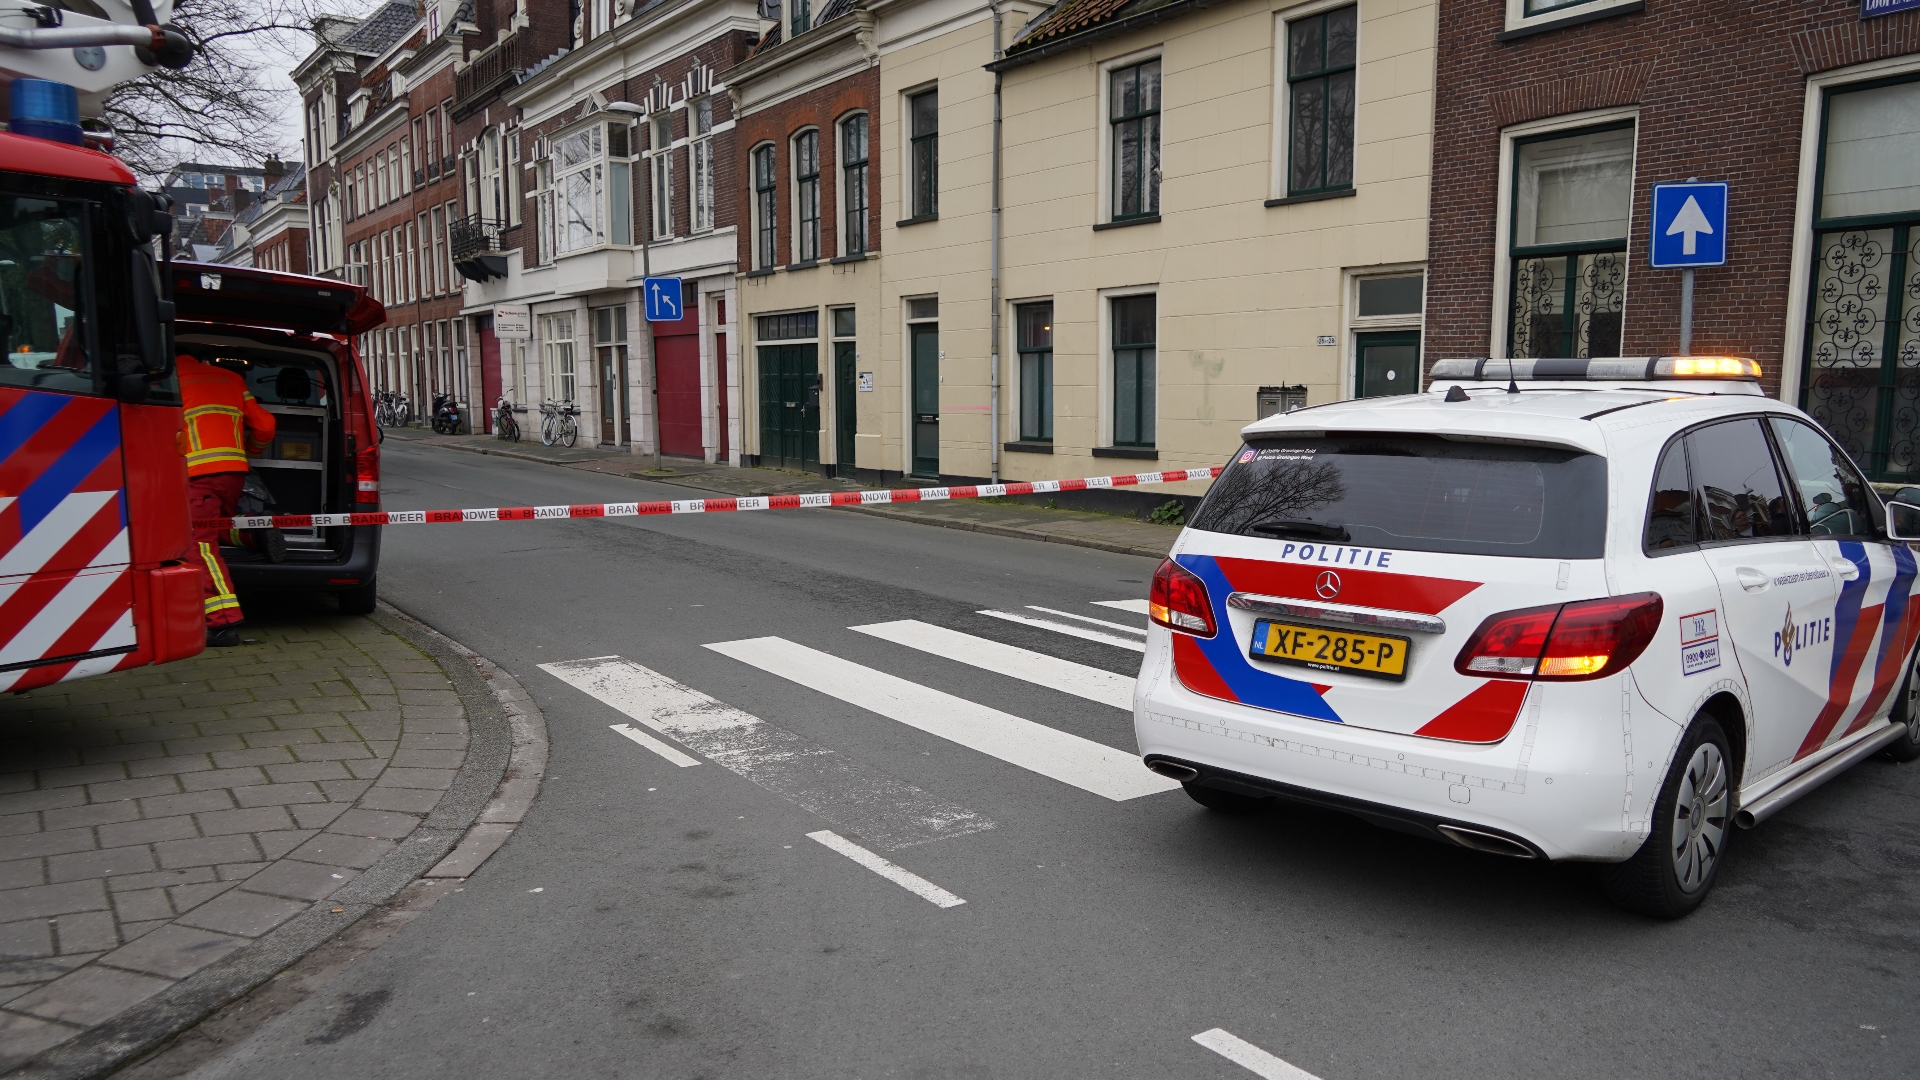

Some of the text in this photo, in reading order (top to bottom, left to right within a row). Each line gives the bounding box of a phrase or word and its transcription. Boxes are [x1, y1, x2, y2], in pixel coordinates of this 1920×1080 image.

[247, 516, 331, 528] BRANDWEER
[343, 512, 424, 525] BRANDWEER
[434, 509, 512, 522] BRANDWEER
[523, 506, 598, 518] BRANDWEER
[608, 501, 681, 515] BRANDWEER
[689, 498, 759, 511] BRANDWEER
[768, 495, 835, 507] BRANDWEER
[844, 491, 908, 503] BRANDWEER
[917, 487, 977, 499] BRANDWEER
[985, 483, 1045, 494] BRANDWEER
[1051, 478, 1109, 489] BRANDWEER
[1116, 473, 1170, 484] BRANDWEER
[1281, 543, 1393, 568] POLITIE
[1254, 640, 1264, 650] NL
[1273, 628, 1394, 668] XF-285-P
[1685, 652, 1699, 664] 0900
[1774, 617, 1830, 667] POLITIE
